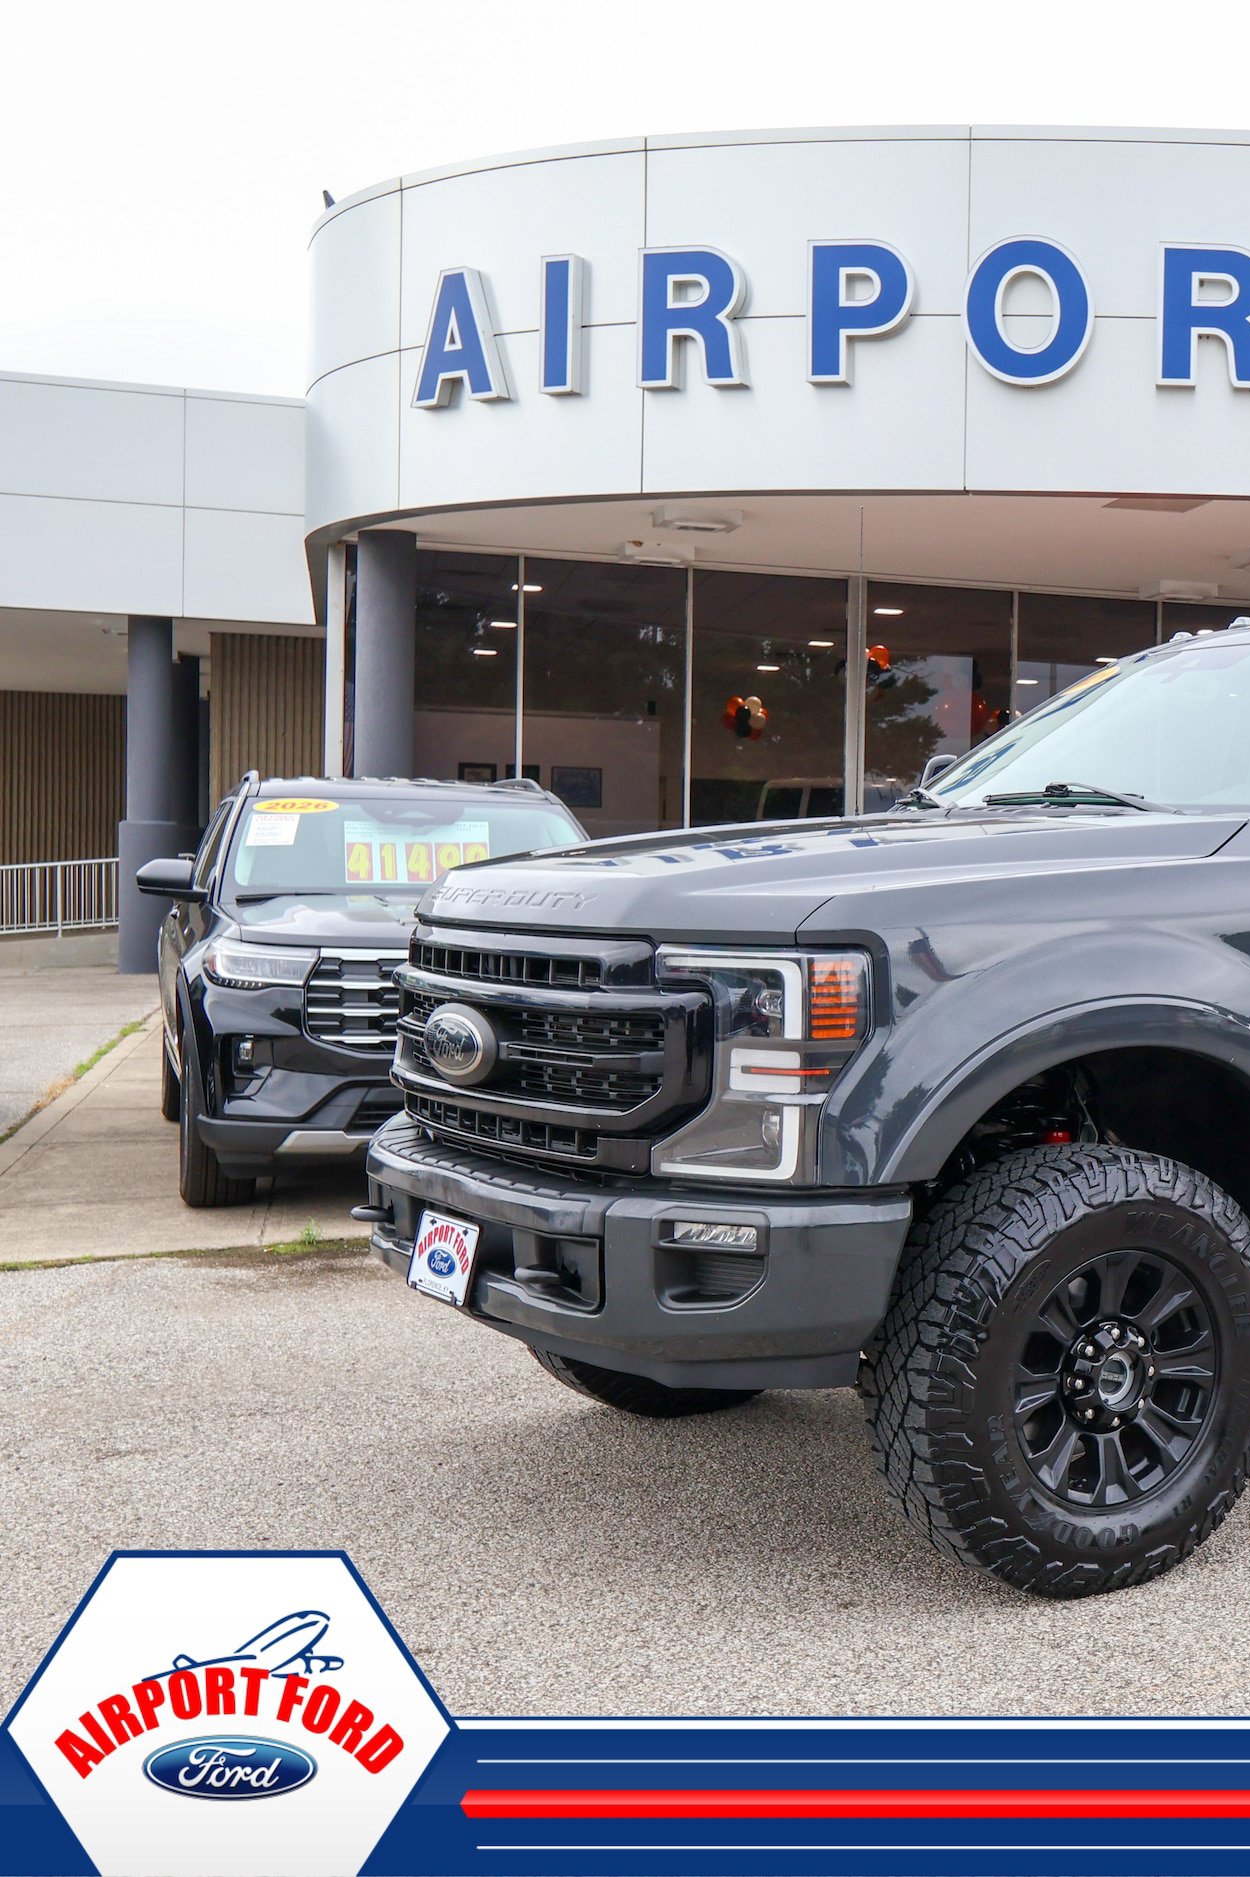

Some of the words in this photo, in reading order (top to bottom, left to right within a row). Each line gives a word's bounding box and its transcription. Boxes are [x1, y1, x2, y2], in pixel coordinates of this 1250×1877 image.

[262, 801, 330, 811] 2026
[432, 885, 502, 906] SUPER
[503, 890, 601, 911] DUTY
[433, 1025, 466, 1061] Ford
[417, 1224, 456, 1261] AIRPORT
[452, 1232, 470, 1277] FORD
[430, 1250, 451, 1274] Ford
